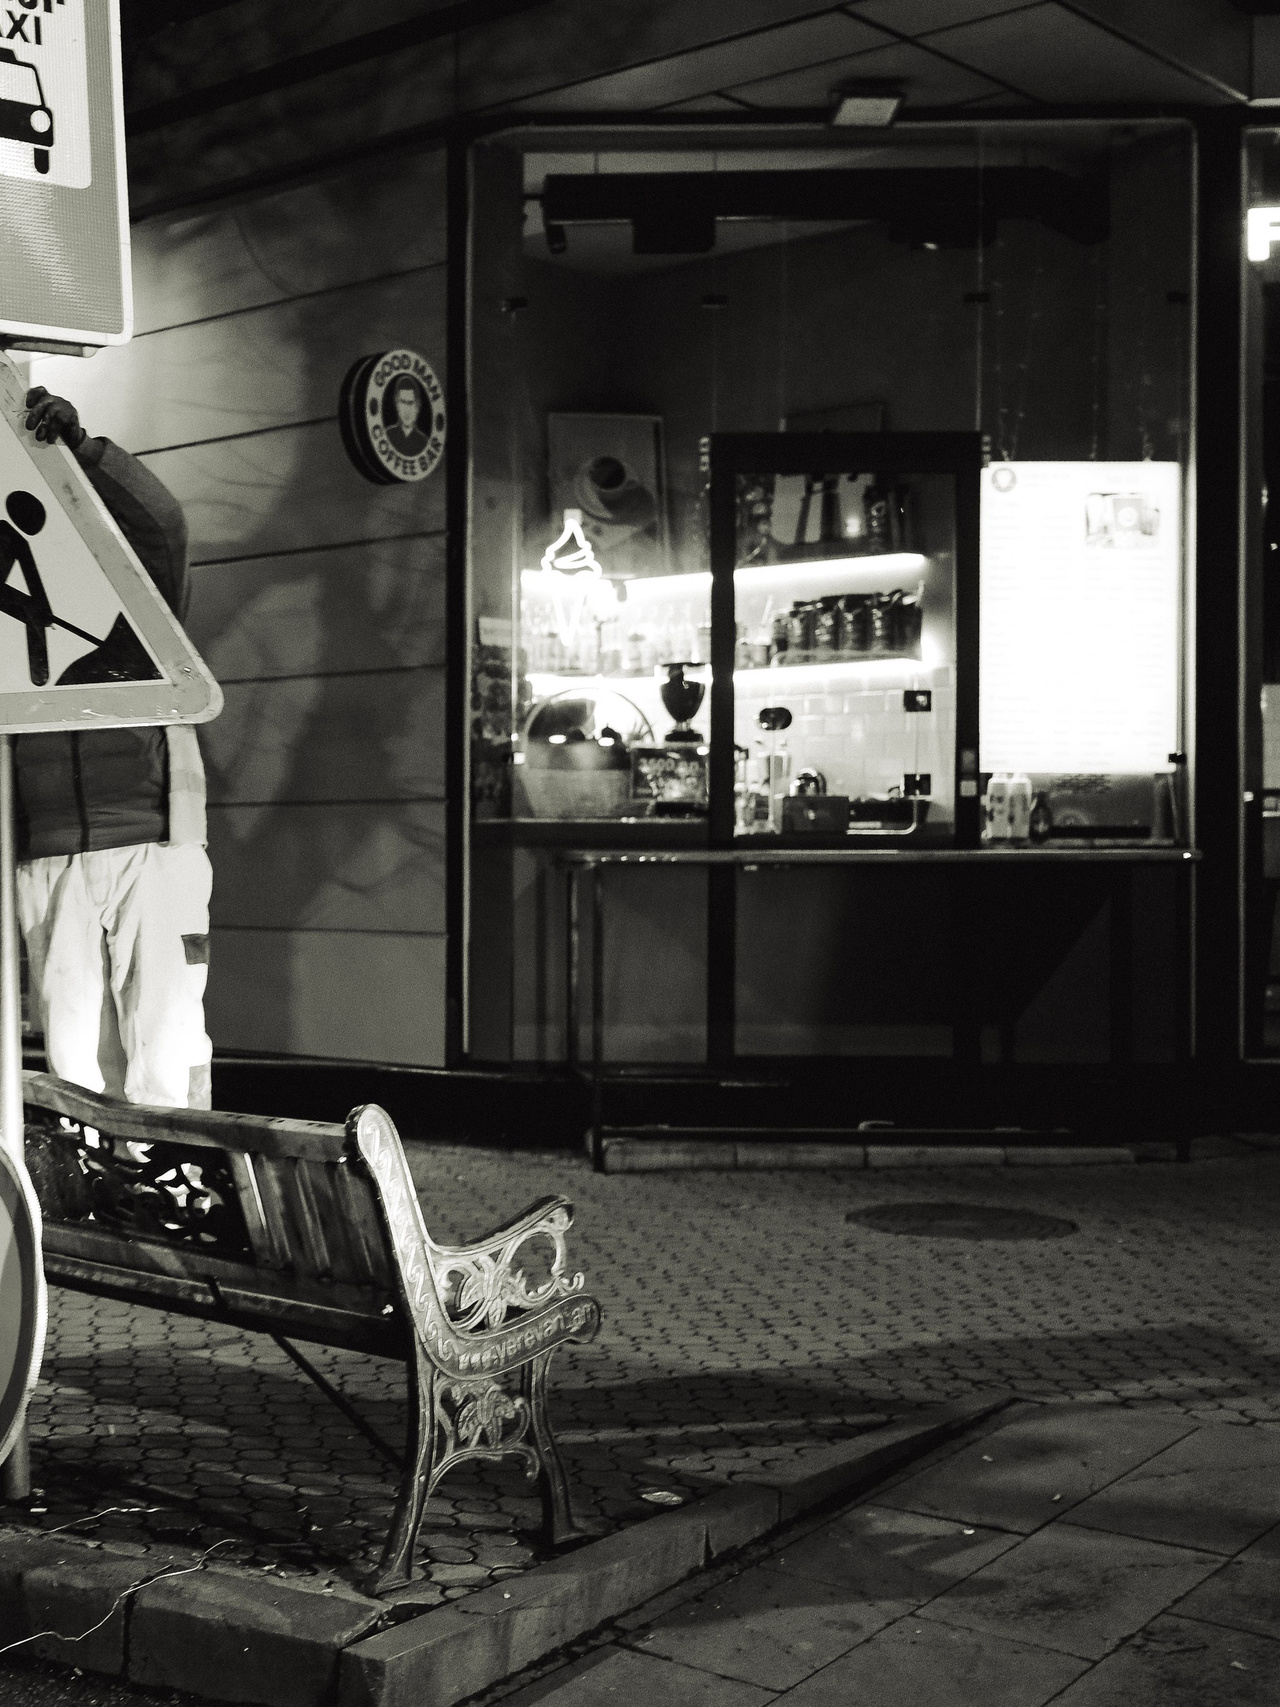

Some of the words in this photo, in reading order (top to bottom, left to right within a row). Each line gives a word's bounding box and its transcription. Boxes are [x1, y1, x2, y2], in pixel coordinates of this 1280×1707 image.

[375, 354, 412, 388] GOOD
[412, 359, 441, 401] MAN
[372, 424, 417, 476] COFFEE
[419, 437, 442, 472] BAR
